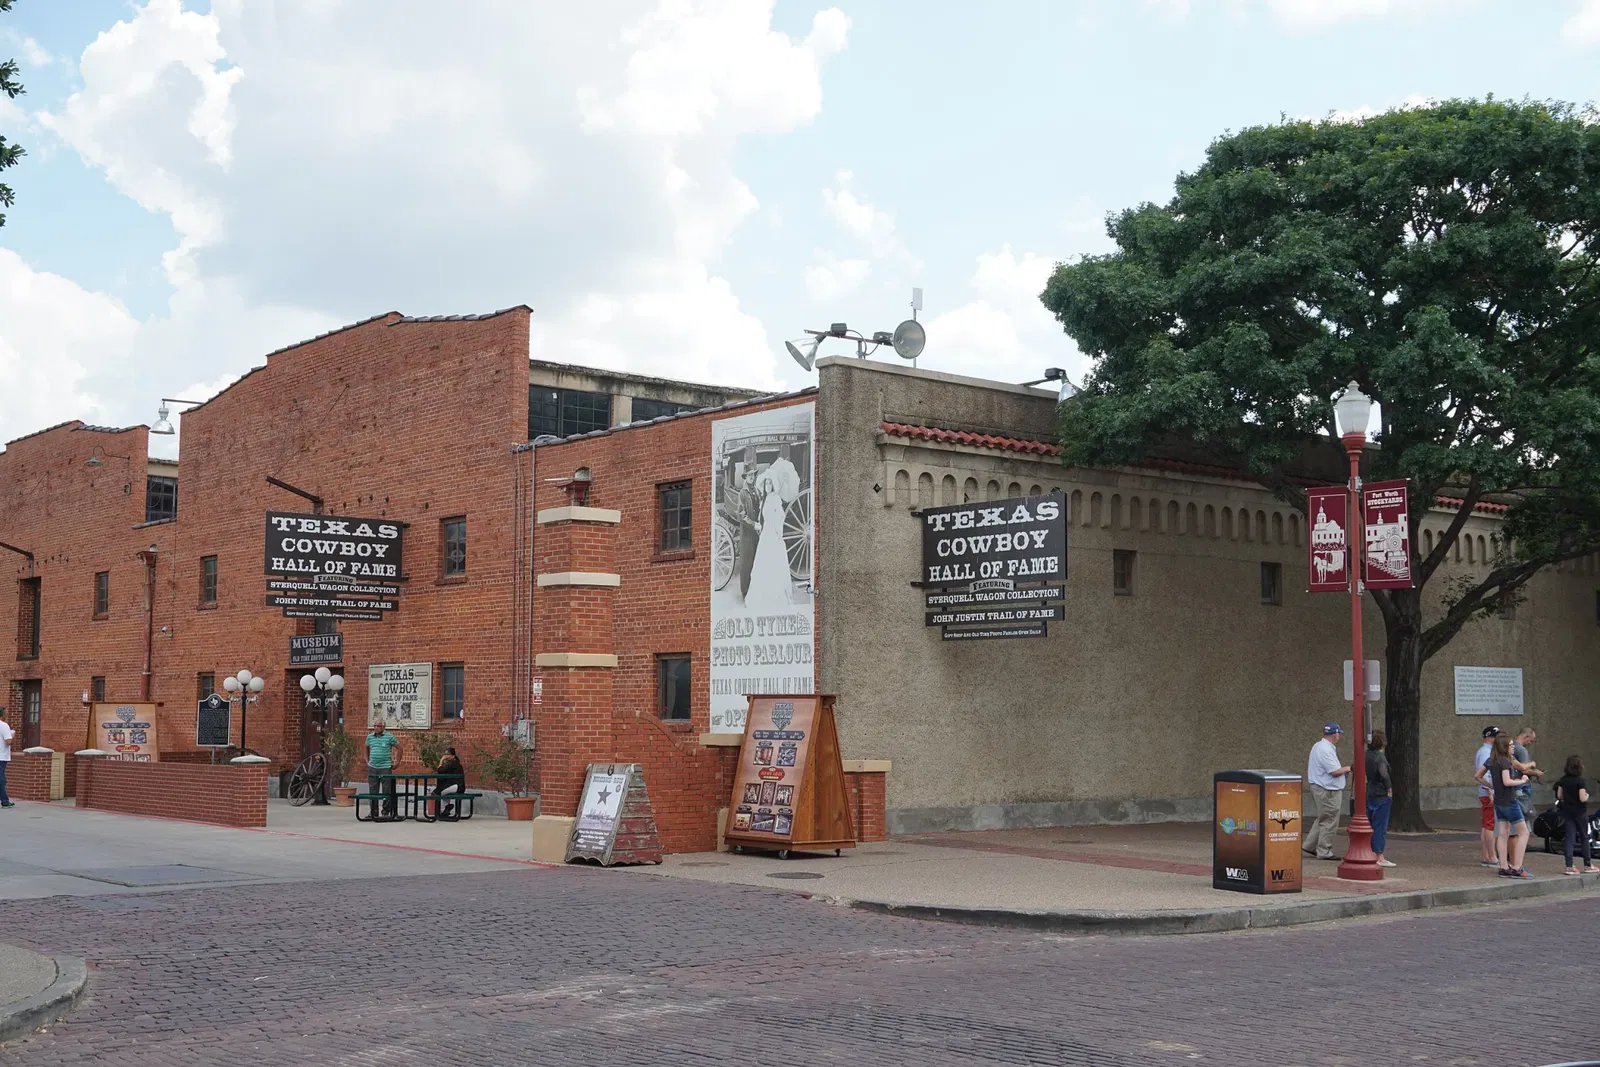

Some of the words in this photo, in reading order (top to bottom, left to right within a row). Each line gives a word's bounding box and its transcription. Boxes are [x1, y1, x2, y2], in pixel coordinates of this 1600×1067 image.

[927, 502, 1059, 532] TEXAS
[272, 516, 398, 538] TEXAS
[281, 538, 389, 558] COWBOY
[936, 530, 1049, 557] COWBOY
[272, 557, 320, 572] HALL
[324, 561, 346, 574] OF
[350, 562, 396, 577] FAME
[929, 564, 976, 582] HALL
[980, 561, 1002, 578] OF
[1007, 556, 1058, 576] FAME
[270, 582, 318, 590] STERQUELL
[350, 585, 396, 594] COLLECTION
[928, 594, 974, 604] STERQUELL
[975, 592, 1006, 602] WAGON
[1007, 589, 1060, 600] COLLECTION
[299, 598, 329, 606] JUSTIN
[933, 615, 954, 623] JOHN
[955, 613, 985, 622] JUSTIN
[987, 612, 1014, 620] TRAIL
[1016, 610, 1028, 619] OF
[1029, 609, 1054, 618] FAME
[726, 617, 754, 639] OLD
[757, 614, 797, 637] TYME
[292, 636, 340, 648] MUSEUM
[712, 645, 751, 667] PHOTO
[753, 642, 812, 666] PARLOUR
[384, 669, 414, 681] TEXAS
[378, 682, 419, 694] COWBOY
[712, 679, 732, 695] TEXAS
[734, 678, 760, 694] COWBOY
[763, 678, 780, 694] HALL
[782, 677, 791, 694] OF
[794, 676, 812, 694] FAME
